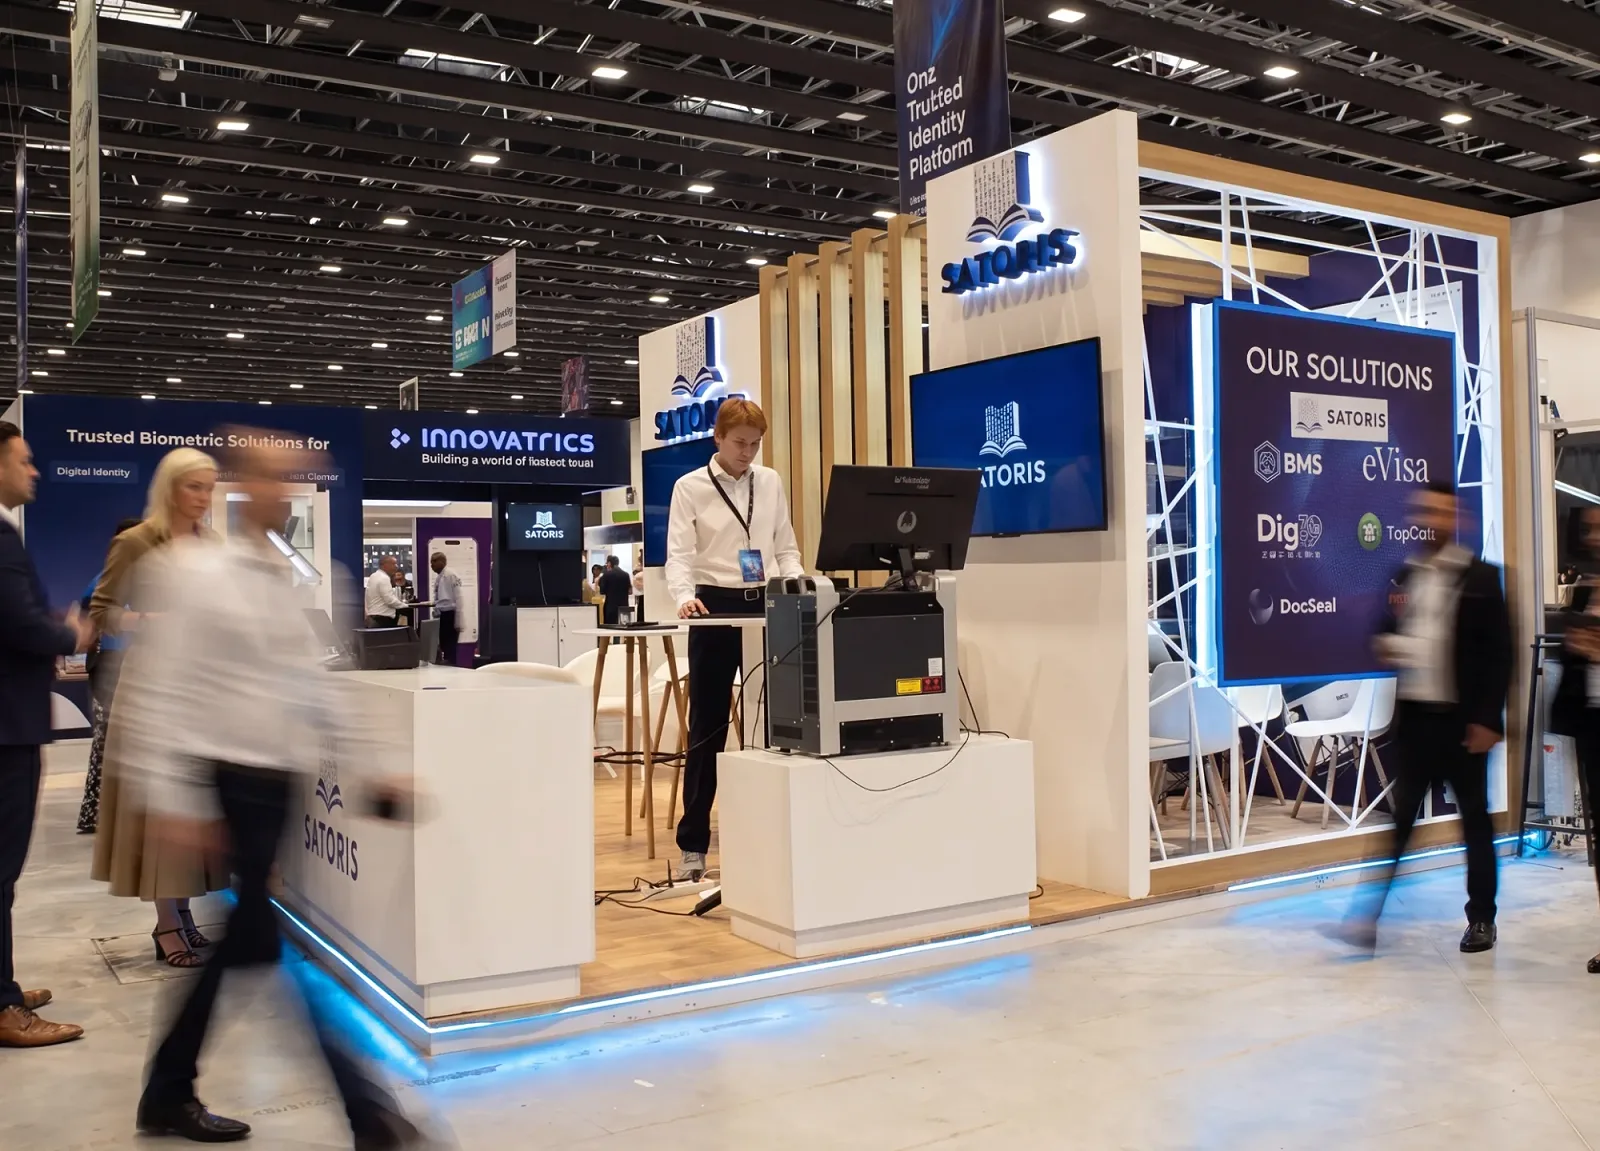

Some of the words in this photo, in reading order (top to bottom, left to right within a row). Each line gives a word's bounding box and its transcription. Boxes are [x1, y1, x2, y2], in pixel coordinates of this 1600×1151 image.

[909, 109, 966, 151] Identity
[910, 136, 973, 180] Platform
[941, 228, 1080, 294] SATORIS
[1246, 346, 1299, 378] OUR
[1307, 353, 1433, 391] SOLUTIONS
[1327, 409, 1386, 428] SATORIS
[66, 429, 135, 445] Trusted
[140, 431, 224, 447] Biometric
[228, 434, 304, 449] Solutions
[307, 437, 330, 450] for
[421, 428, 595, 453] INNOVATRICS
[57, 467, 91, 477] Digital
[422, 454, 469, 467] Building
[472, 457, 479, 465] a
[481, 456, 513, 466] world
[515, 456, 527, 466] of
[1284, 453, 1322, 475] BMS
[1362, 446, 1430, 482] eVisa
[977, 460, 1046, 488] ATORIS
[525, 530, 564, 538] SATORIS
[1280, 596, 1336, 614] DocSeal
[304, 814, 358, 881] SATORIS
